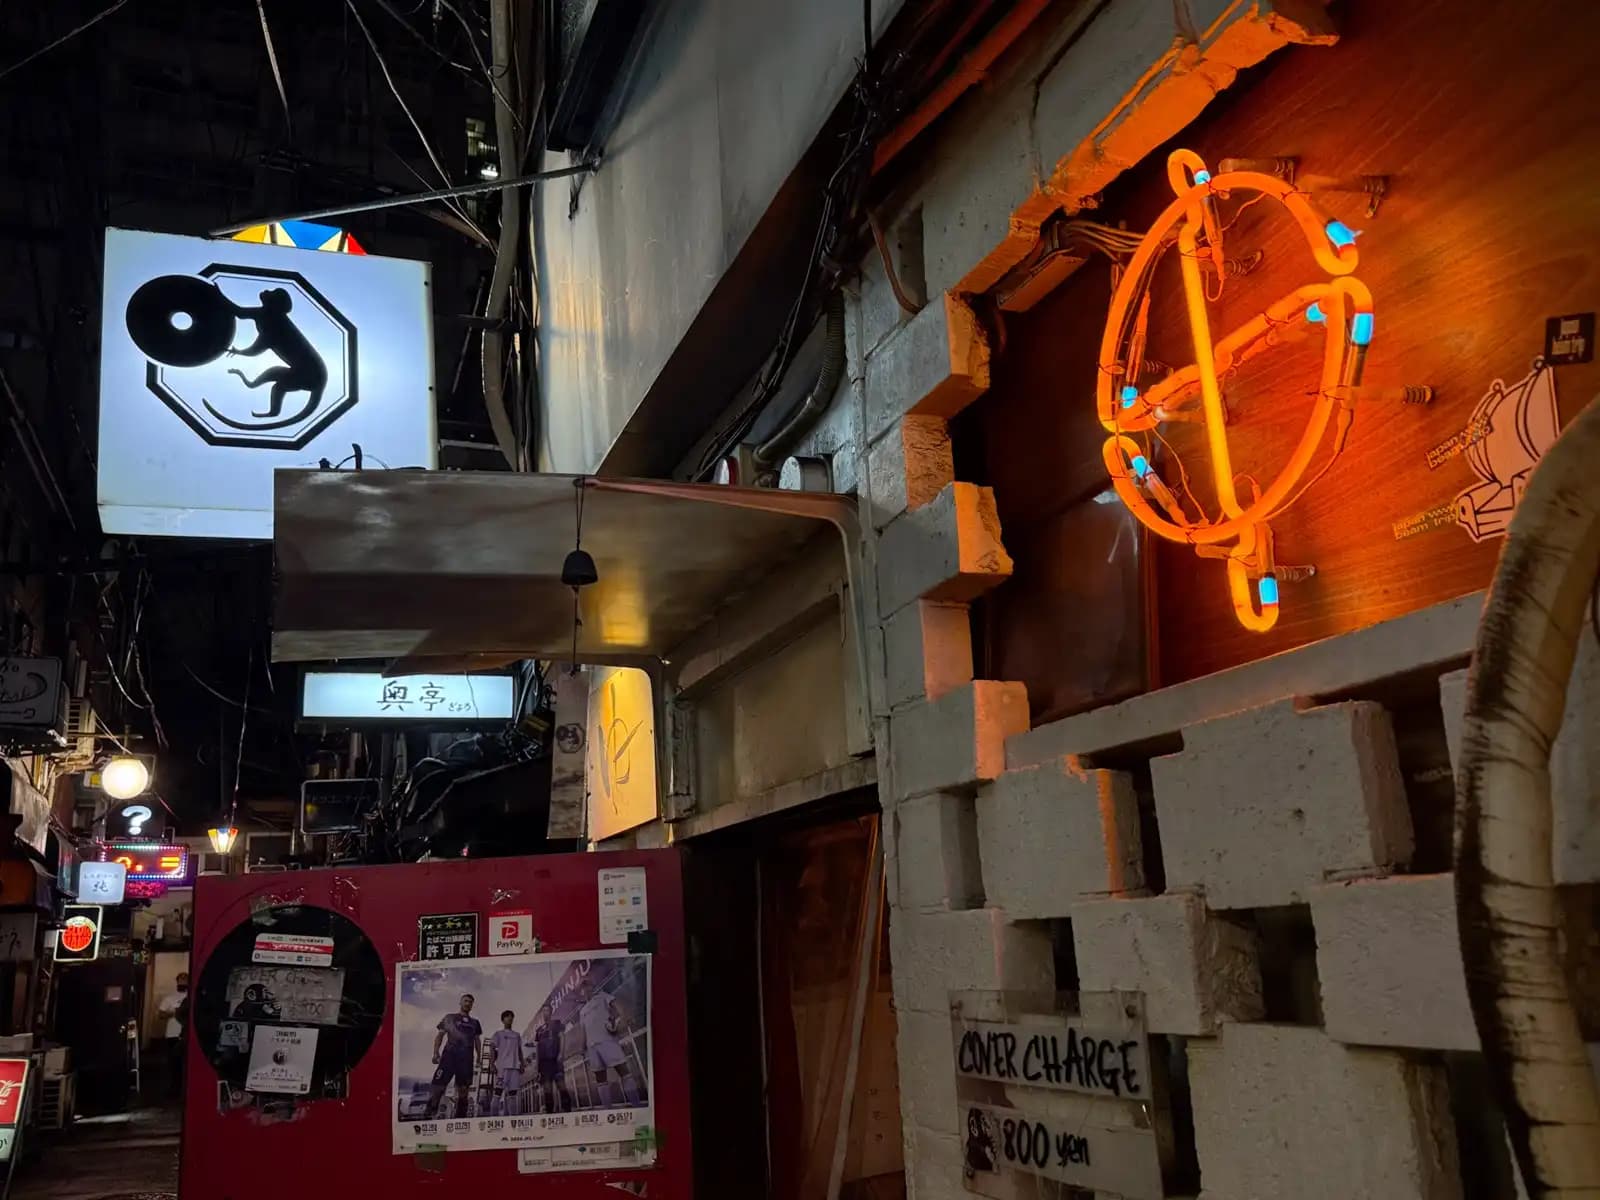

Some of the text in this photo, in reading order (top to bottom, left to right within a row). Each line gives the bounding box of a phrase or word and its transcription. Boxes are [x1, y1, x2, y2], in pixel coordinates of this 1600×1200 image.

[426, 943, 472, 958] 許可店
[496, 940, 524, 949] PayPay
[958, 1027, 1140, 1096] COVER CHARGE
[1002, 1118, 1091, 1168] 800 yen
